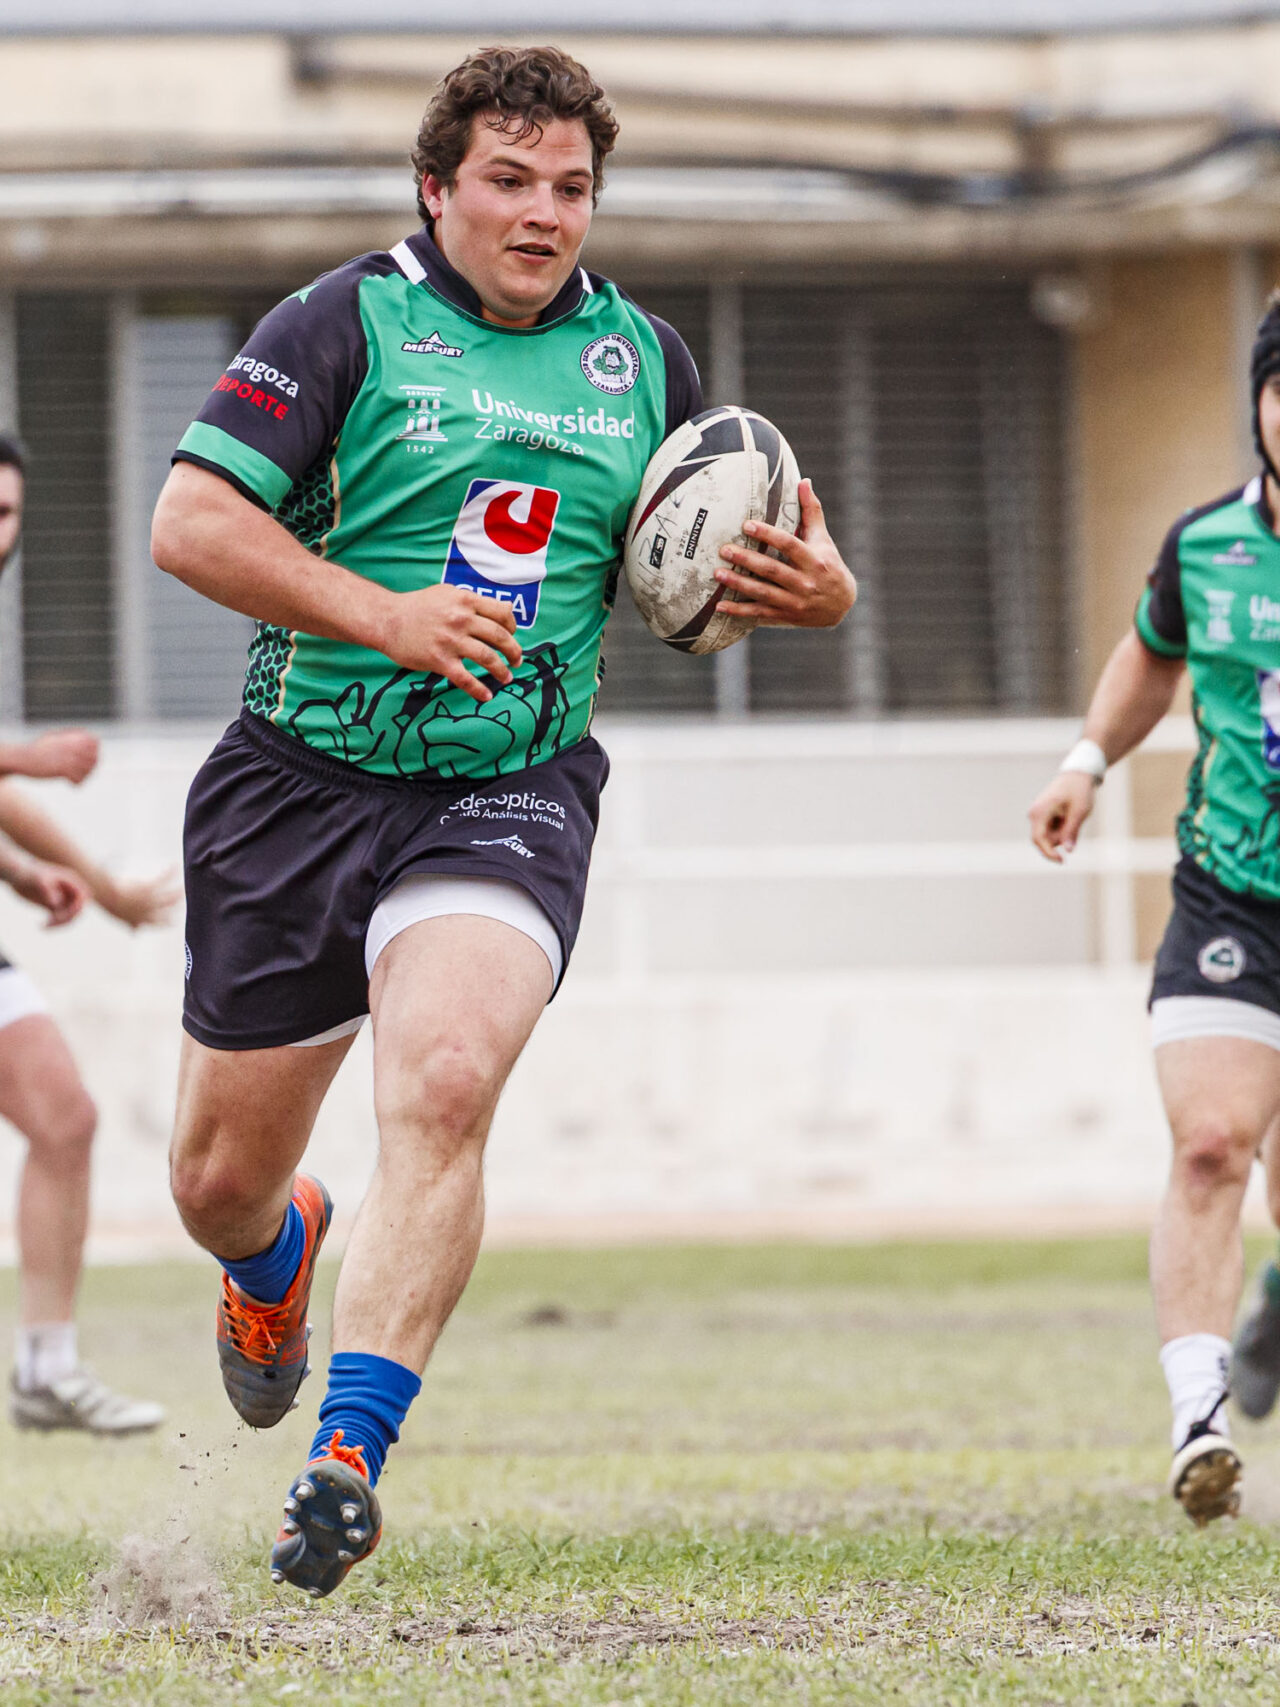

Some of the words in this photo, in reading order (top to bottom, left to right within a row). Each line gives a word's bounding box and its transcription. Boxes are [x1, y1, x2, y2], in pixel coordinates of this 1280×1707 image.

[471, 388, 635, 439] Universidad
[406, 444, 435, 455] 1542
[474, 416, 584, 456] Zaragoza
[686, 509, 708, 559] TRAINING
[482, 808, 529, 822] Análisis
[531, 813, 564, 831] Visual
